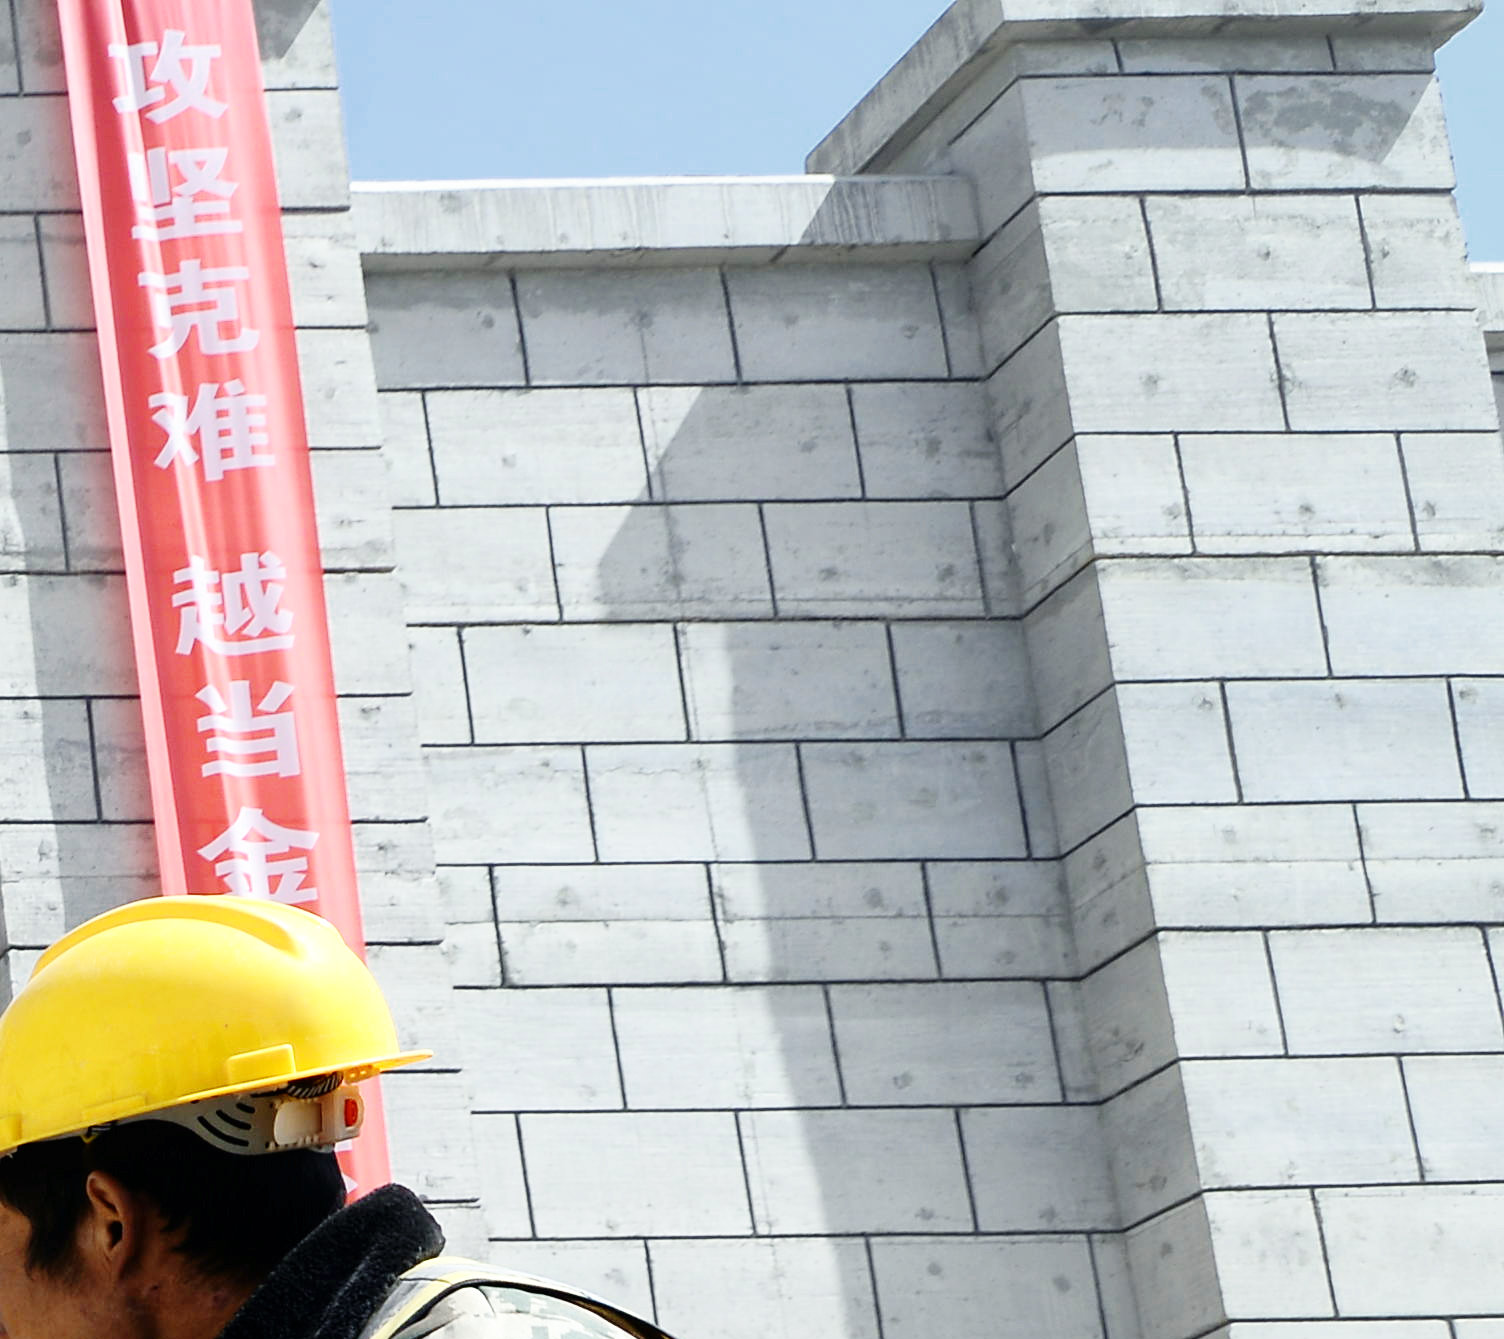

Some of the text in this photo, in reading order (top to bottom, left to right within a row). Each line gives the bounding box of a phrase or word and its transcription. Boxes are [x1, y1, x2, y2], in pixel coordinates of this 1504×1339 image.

[110, 27, 321, 904] 攻坚克难 越当金
